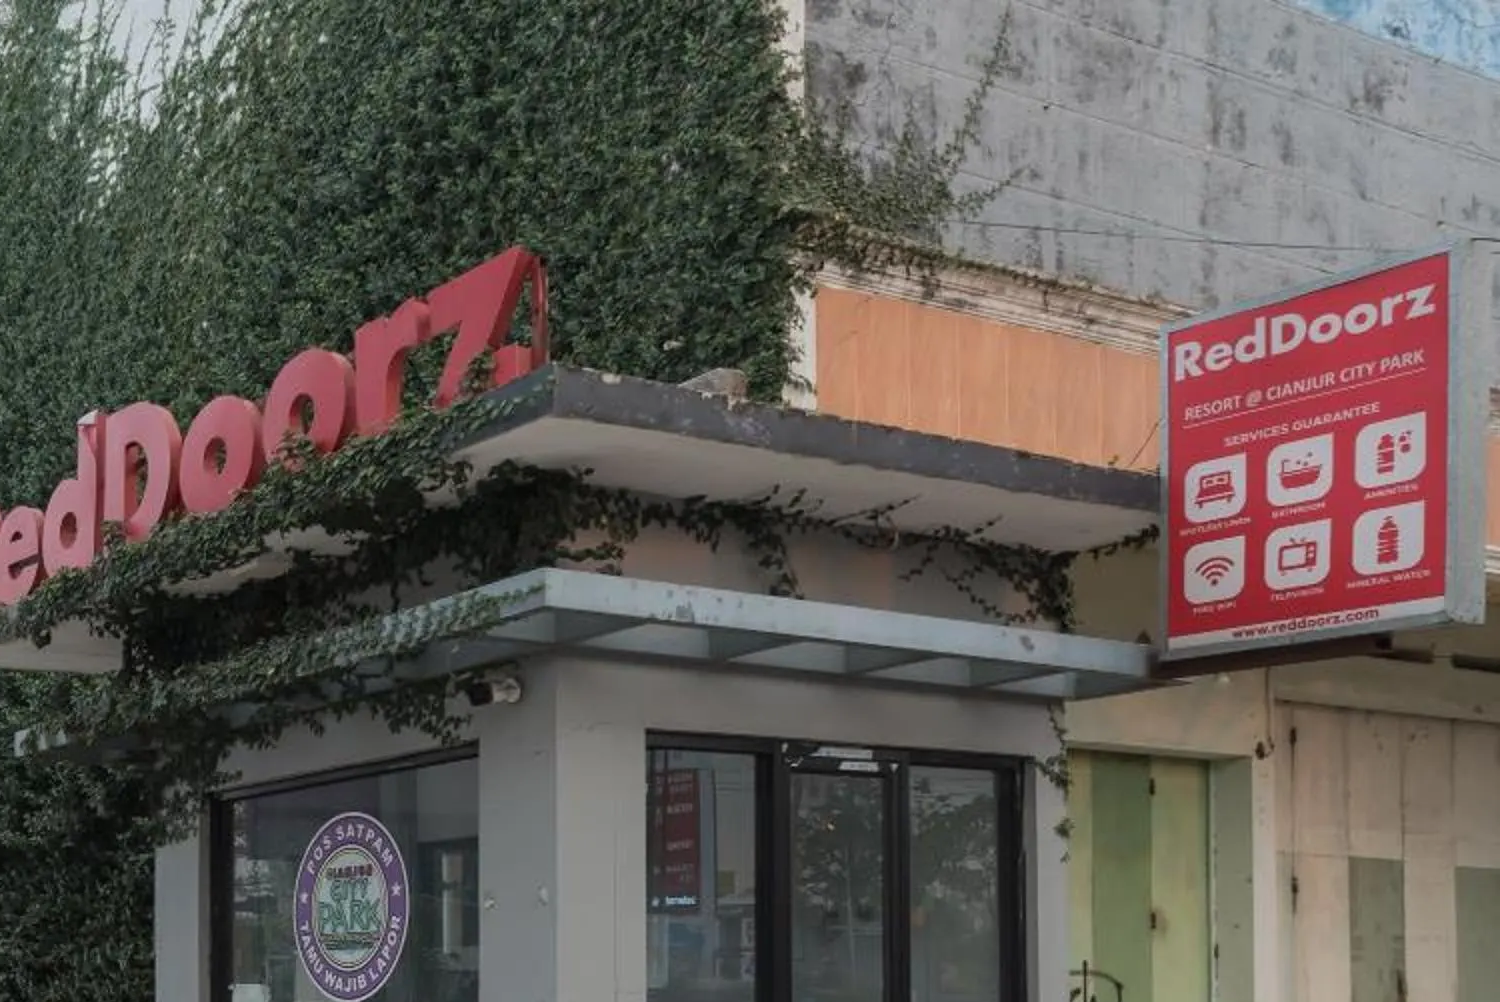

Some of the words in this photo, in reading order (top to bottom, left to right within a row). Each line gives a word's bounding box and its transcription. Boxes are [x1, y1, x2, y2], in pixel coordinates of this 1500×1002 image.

[1174, 284, 1436, 382] RedDoorz
[1184, 395, 1242, 421] RESORT
[1245, 389, 1263, 408] @
[1266, 372, 1335, 401] CIANJUR
[1339, 361, 1376, 384] CITY
[1380, 348, 1425, 372] PARK
[1223, 423, 1289, 447] SERVICES
[1292, 402, 1381, 431] GUARANTEE
[1232, 608, 1380, 639] www.reddoorz.com
[307, 835, 332, 874] POS
[335, 823, 393, 867] SATPAM
[319, 899, 381, 932] PARK
[299, 920, 324, 975] TAMU
[324, 970, 367, 993] WAJIB
[369, 915, 401, 981] LAPOR
